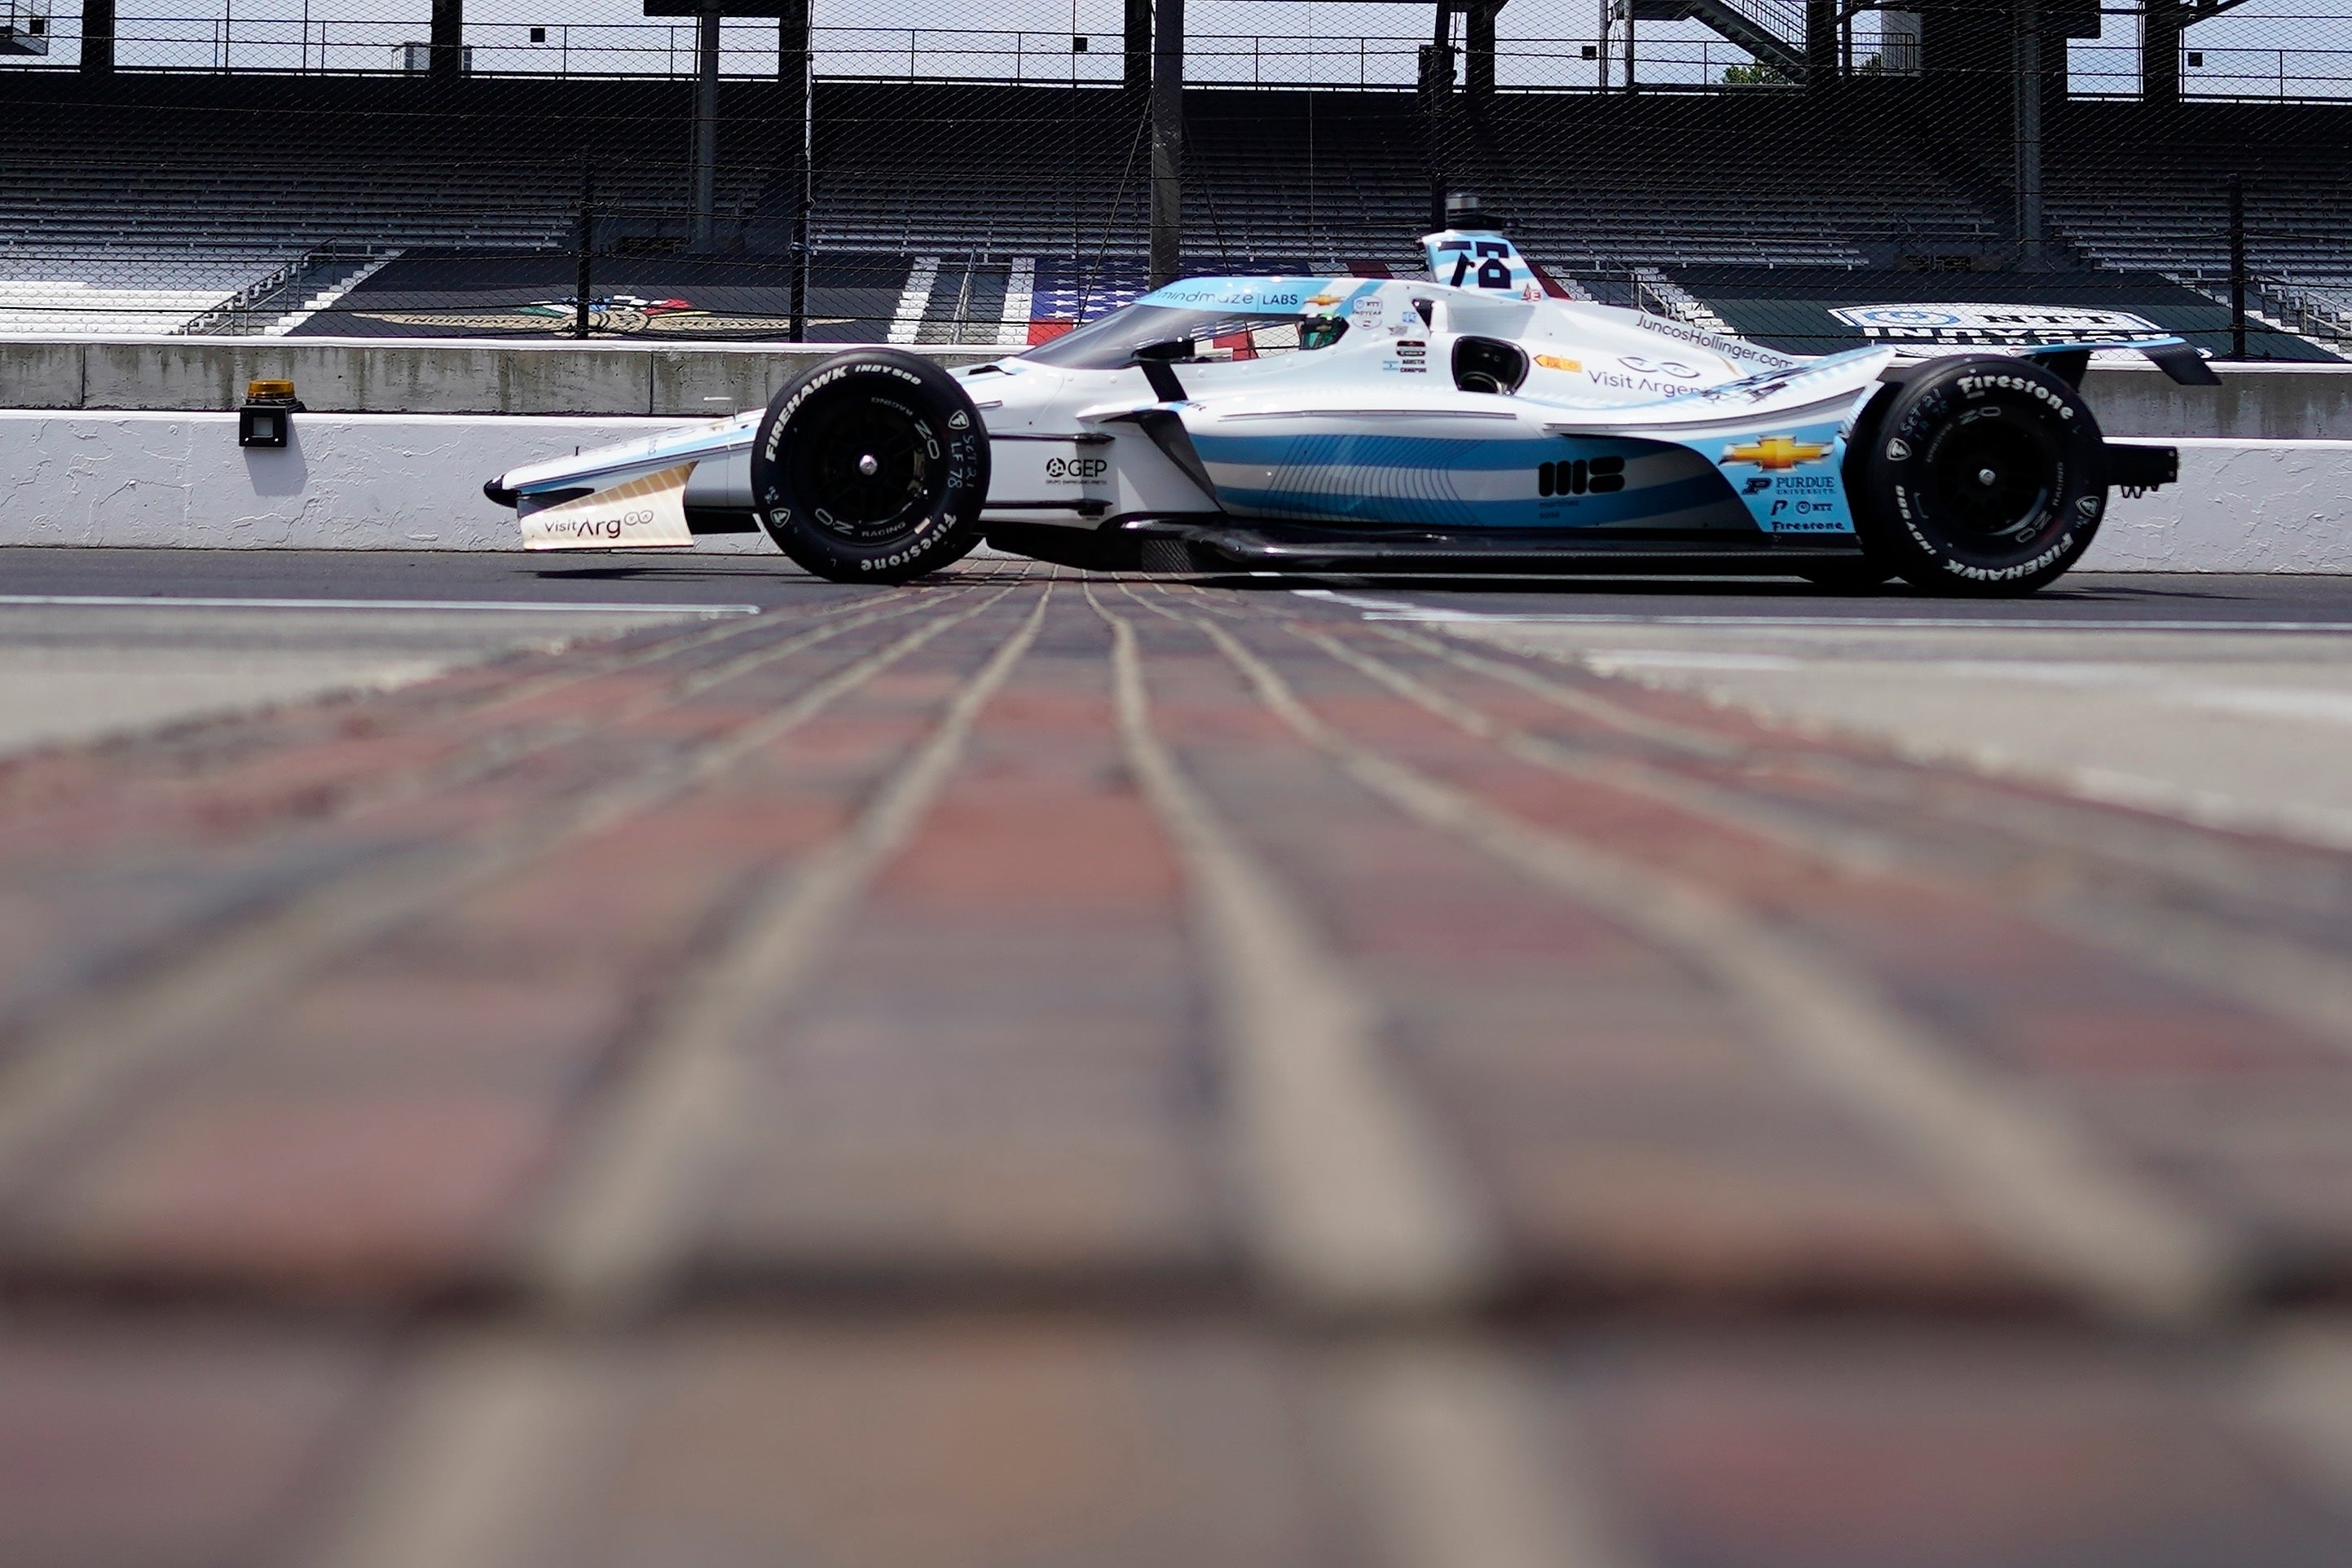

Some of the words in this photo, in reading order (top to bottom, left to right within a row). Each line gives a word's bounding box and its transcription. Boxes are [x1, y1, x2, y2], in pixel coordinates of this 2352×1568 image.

[1435, 240, 1512, 289] 78
[1157, 289, 1253, 305] mindmaze
[1263, 294, 1297, 305] LABS
[1978, 315, 2115, 324] NTT
[1636, 315, 1793, 368] JuncosHollinger.com
[1588, 370, 1632, 389] Visit
[1957, 375, 2074, 420] Firestone
[765, 365, 848, 463] FIREHAWK
[950, 442, 964, 462] LF
[947, 468, 962, 488] 78
[1068, 459, 1107, 477] GEP
[1776, 476, 1834, 488] PURDUE
[544, 520, 576, 532] Visit
[577, 518, 620, 539] Arg
[861, 521, 906, 537] RACING
[1771, 521, 1845, 531] Firestone
[861, 513, 957, 571] Firestone
[1943, 532, 2074, 581] FIREHAWK
